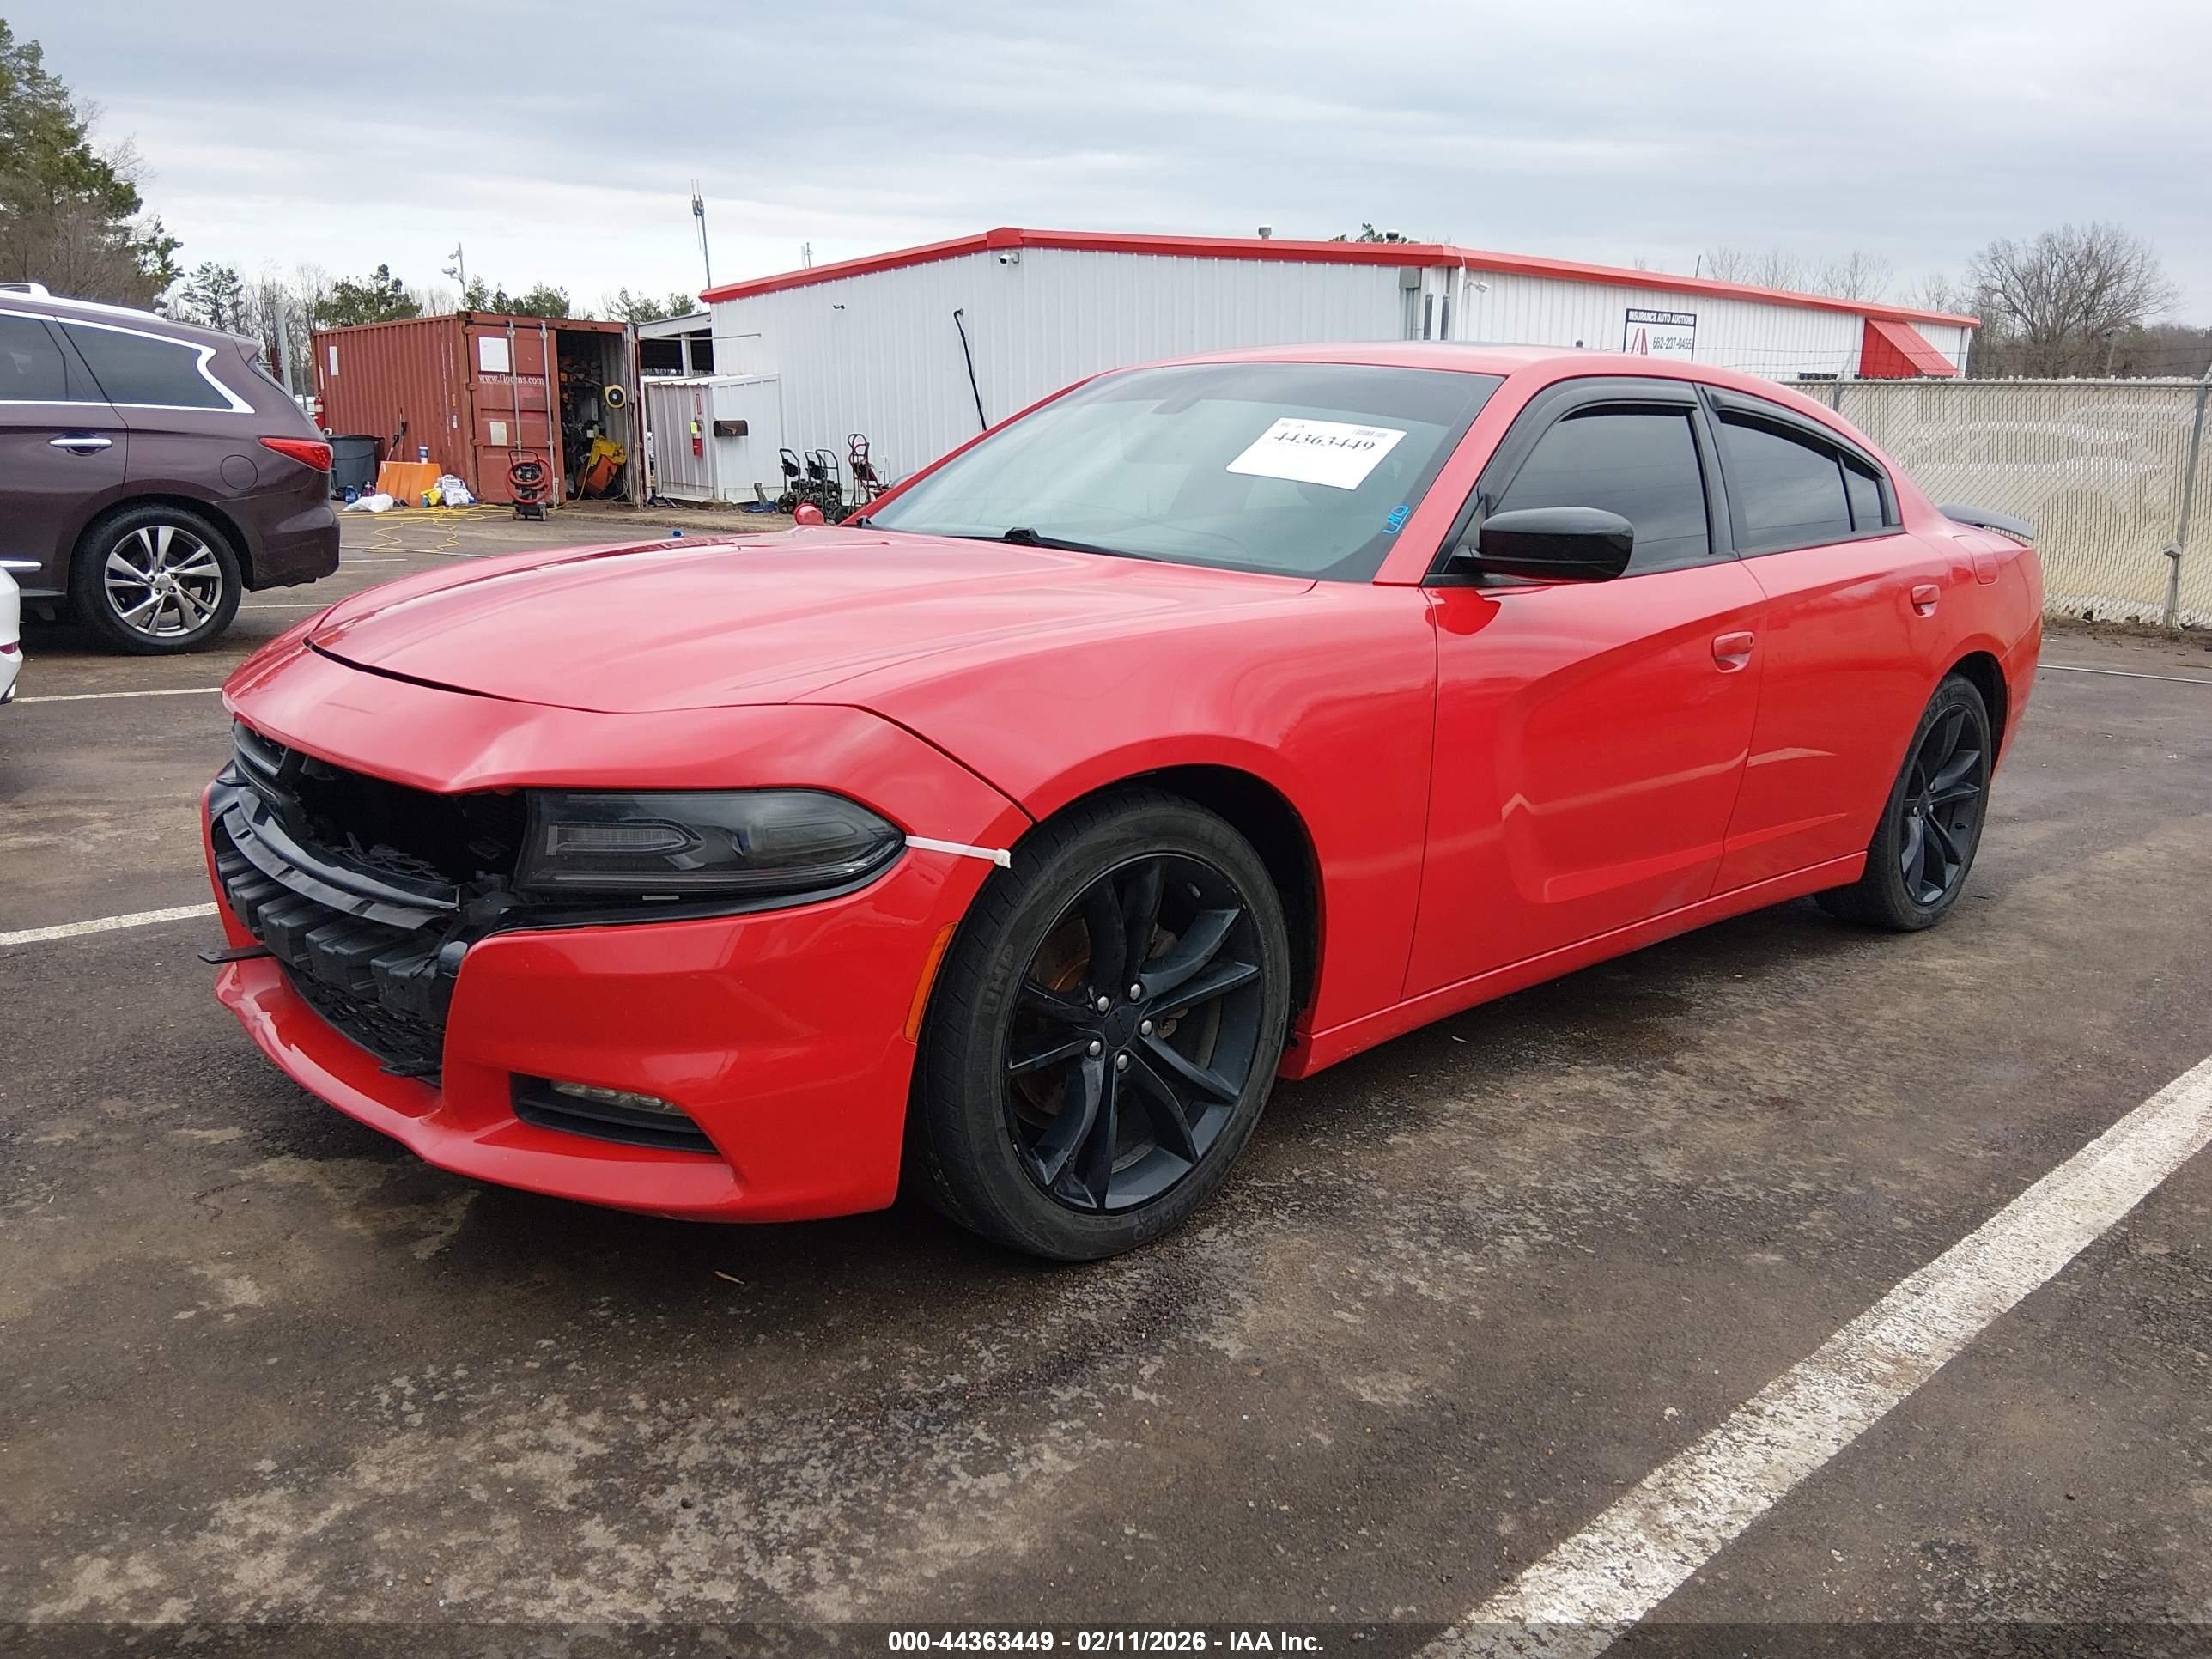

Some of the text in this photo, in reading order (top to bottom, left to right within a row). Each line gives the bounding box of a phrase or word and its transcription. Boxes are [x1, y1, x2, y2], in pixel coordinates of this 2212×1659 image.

[1628, 310, 1695, 325] INSURANCE AUTO AUCTIONS
[478, 374, 544, 386] www.florns.com
[1273, 430, 1376, 452] 44363449
